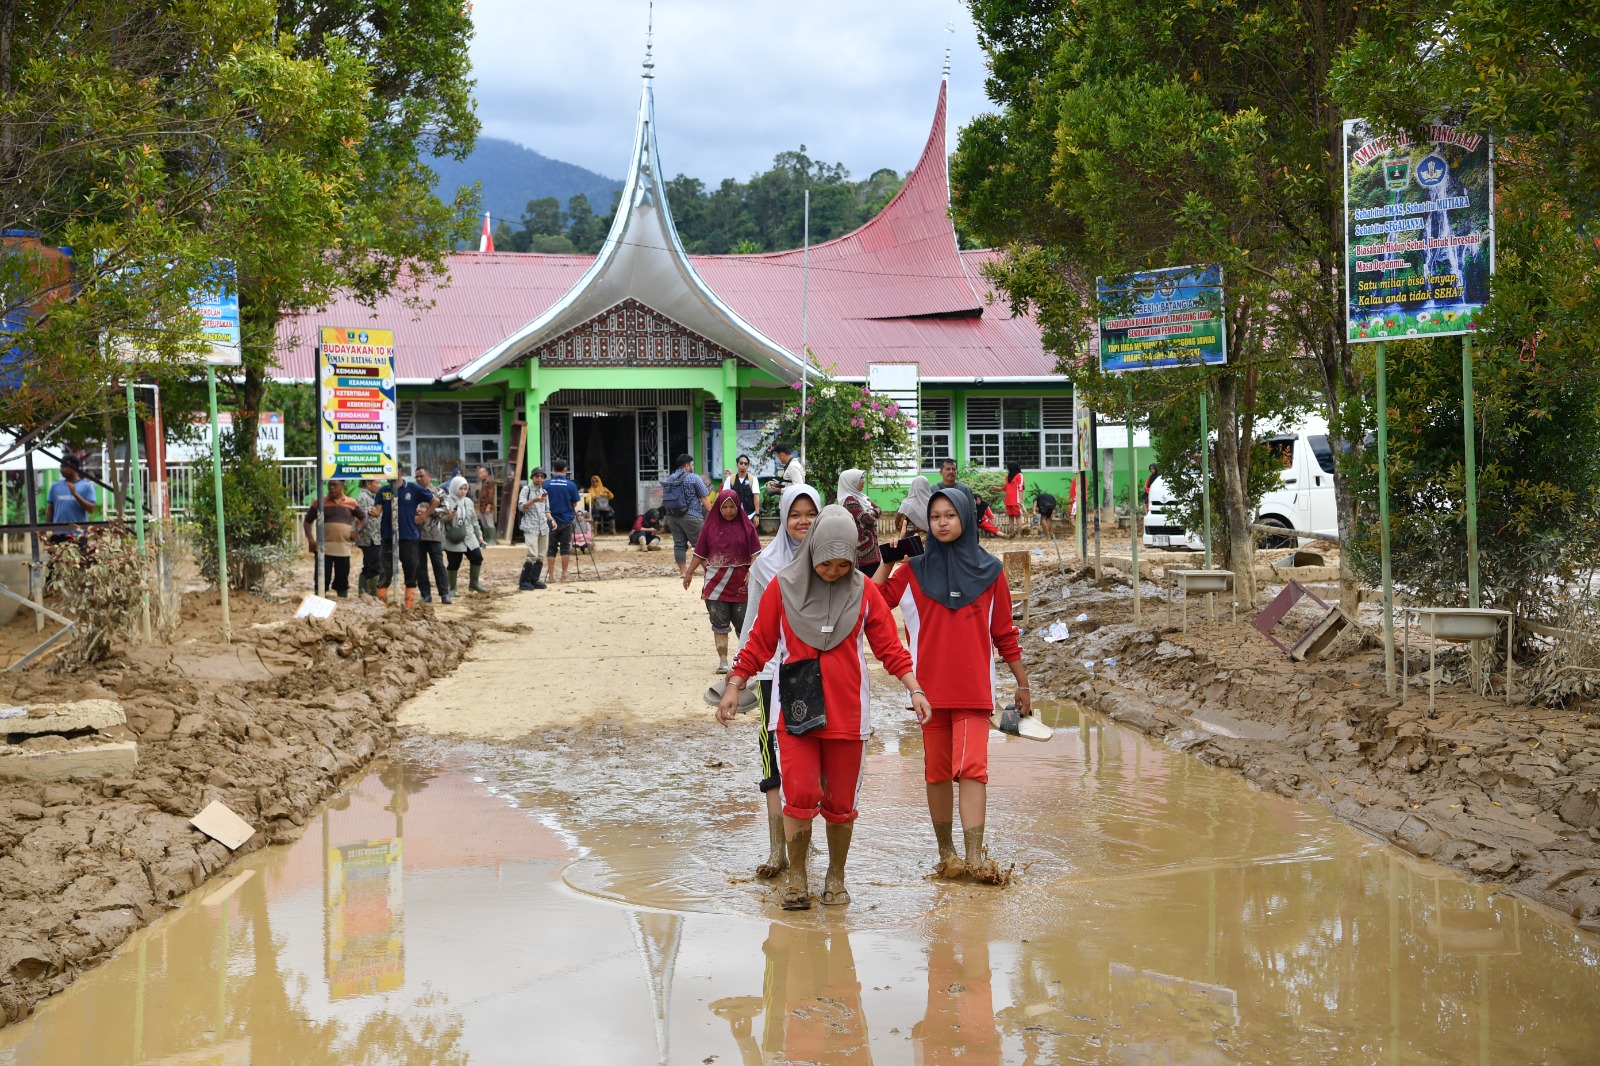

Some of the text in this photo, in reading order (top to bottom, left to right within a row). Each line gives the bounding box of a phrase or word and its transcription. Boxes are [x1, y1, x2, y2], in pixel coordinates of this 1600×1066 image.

[1354, 143, 1377, 165] SMA
[1355, 196, 1470, 220] Sehat itu EMAS, Sehat itu MUTIARA
[1355, 218, 1425, 236] Sehat itu SEGALANYA
[1356, 244, 1385, 256] Biasakan
[1386, 242, 1405, 254] Hidup
[1428, 237, 1449, 248] Untuk
[1450, 233, 1480, 246] Investasi
[1356, 261, 1373, 271] Masa
[1358, 280, 1377, 291] Satu
[1380, 278, 1405, 288] miliar
[1408, 275, 1425, 286] bisa
[1358, 286, 1464, 305] Kalau anda tidak SEHAT
[1160, 300, 1187, 311] BATANG
[1106, 320, 1135, 330] PENDIDIKAN
[1136, 317, 1152, 327] BUKAN
[1170, 312, 1197, 323] TANGGUNG
[1128, 324, 1193, 338] SEKOLAH DAN PEMERINTAH
[323, 344, 392, 356] BUDAYAKAN 10 K
[1108, 344, 1120, 353] TAPI
[329, 355, 345, 364] SMAN
[351, 356, 373, 364] BATANG
[374, 357, 387, 365] ANAI
[348, 379, 381, 387] KEAMANAN
